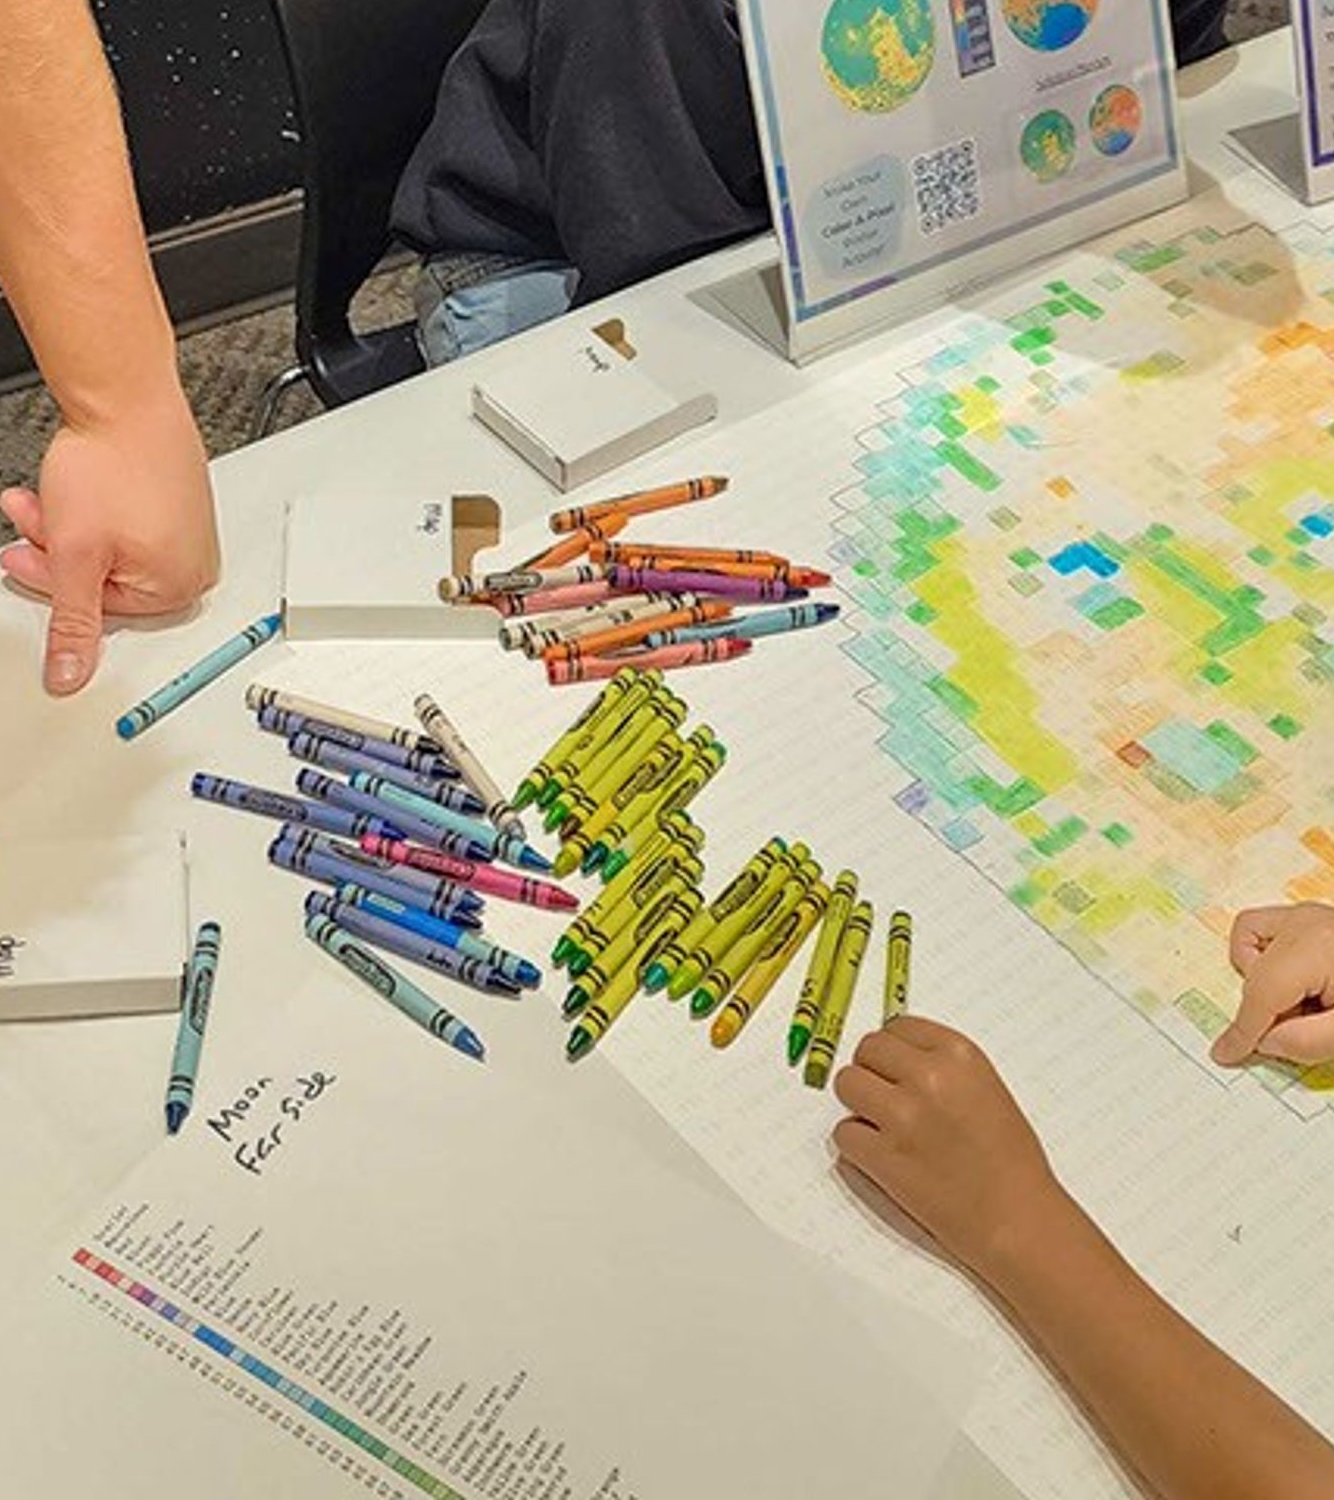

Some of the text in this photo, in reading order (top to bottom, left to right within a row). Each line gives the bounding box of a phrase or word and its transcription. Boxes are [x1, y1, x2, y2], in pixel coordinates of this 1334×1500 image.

[206, 1077, 274, 1143] Moon
[234, 1071, 338, 1176] Far side
